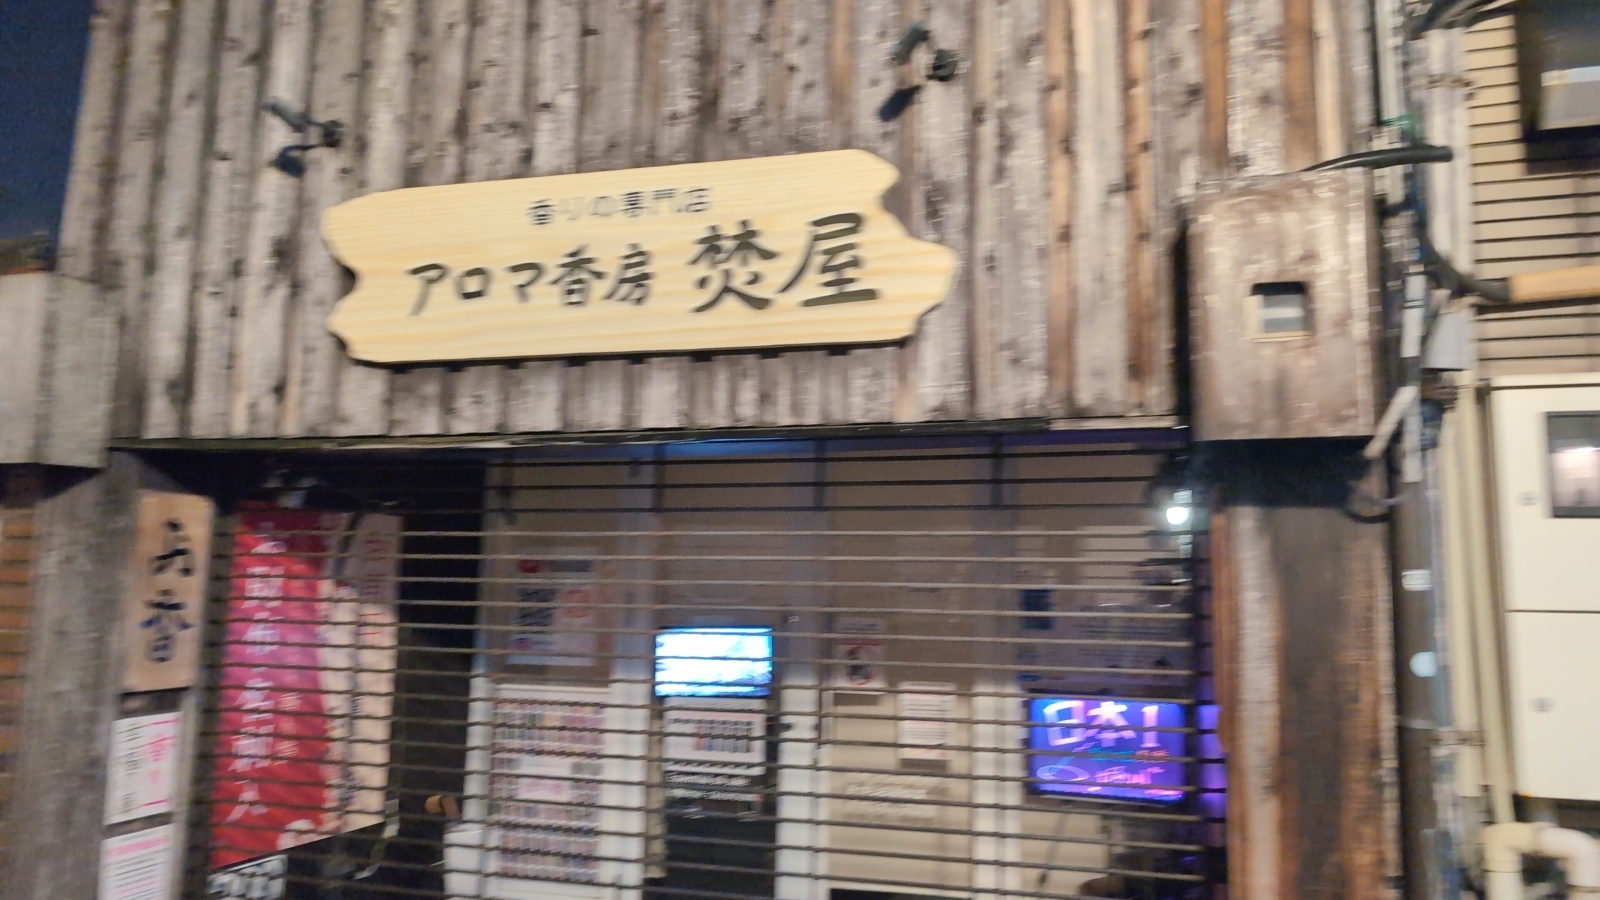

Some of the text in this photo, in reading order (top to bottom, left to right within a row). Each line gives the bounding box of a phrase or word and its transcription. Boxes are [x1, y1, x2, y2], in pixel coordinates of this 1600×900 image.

[527, 187, 711, 226] 香りの専門店
[407, 211, 882, 316] アロマ香房 焚屋
